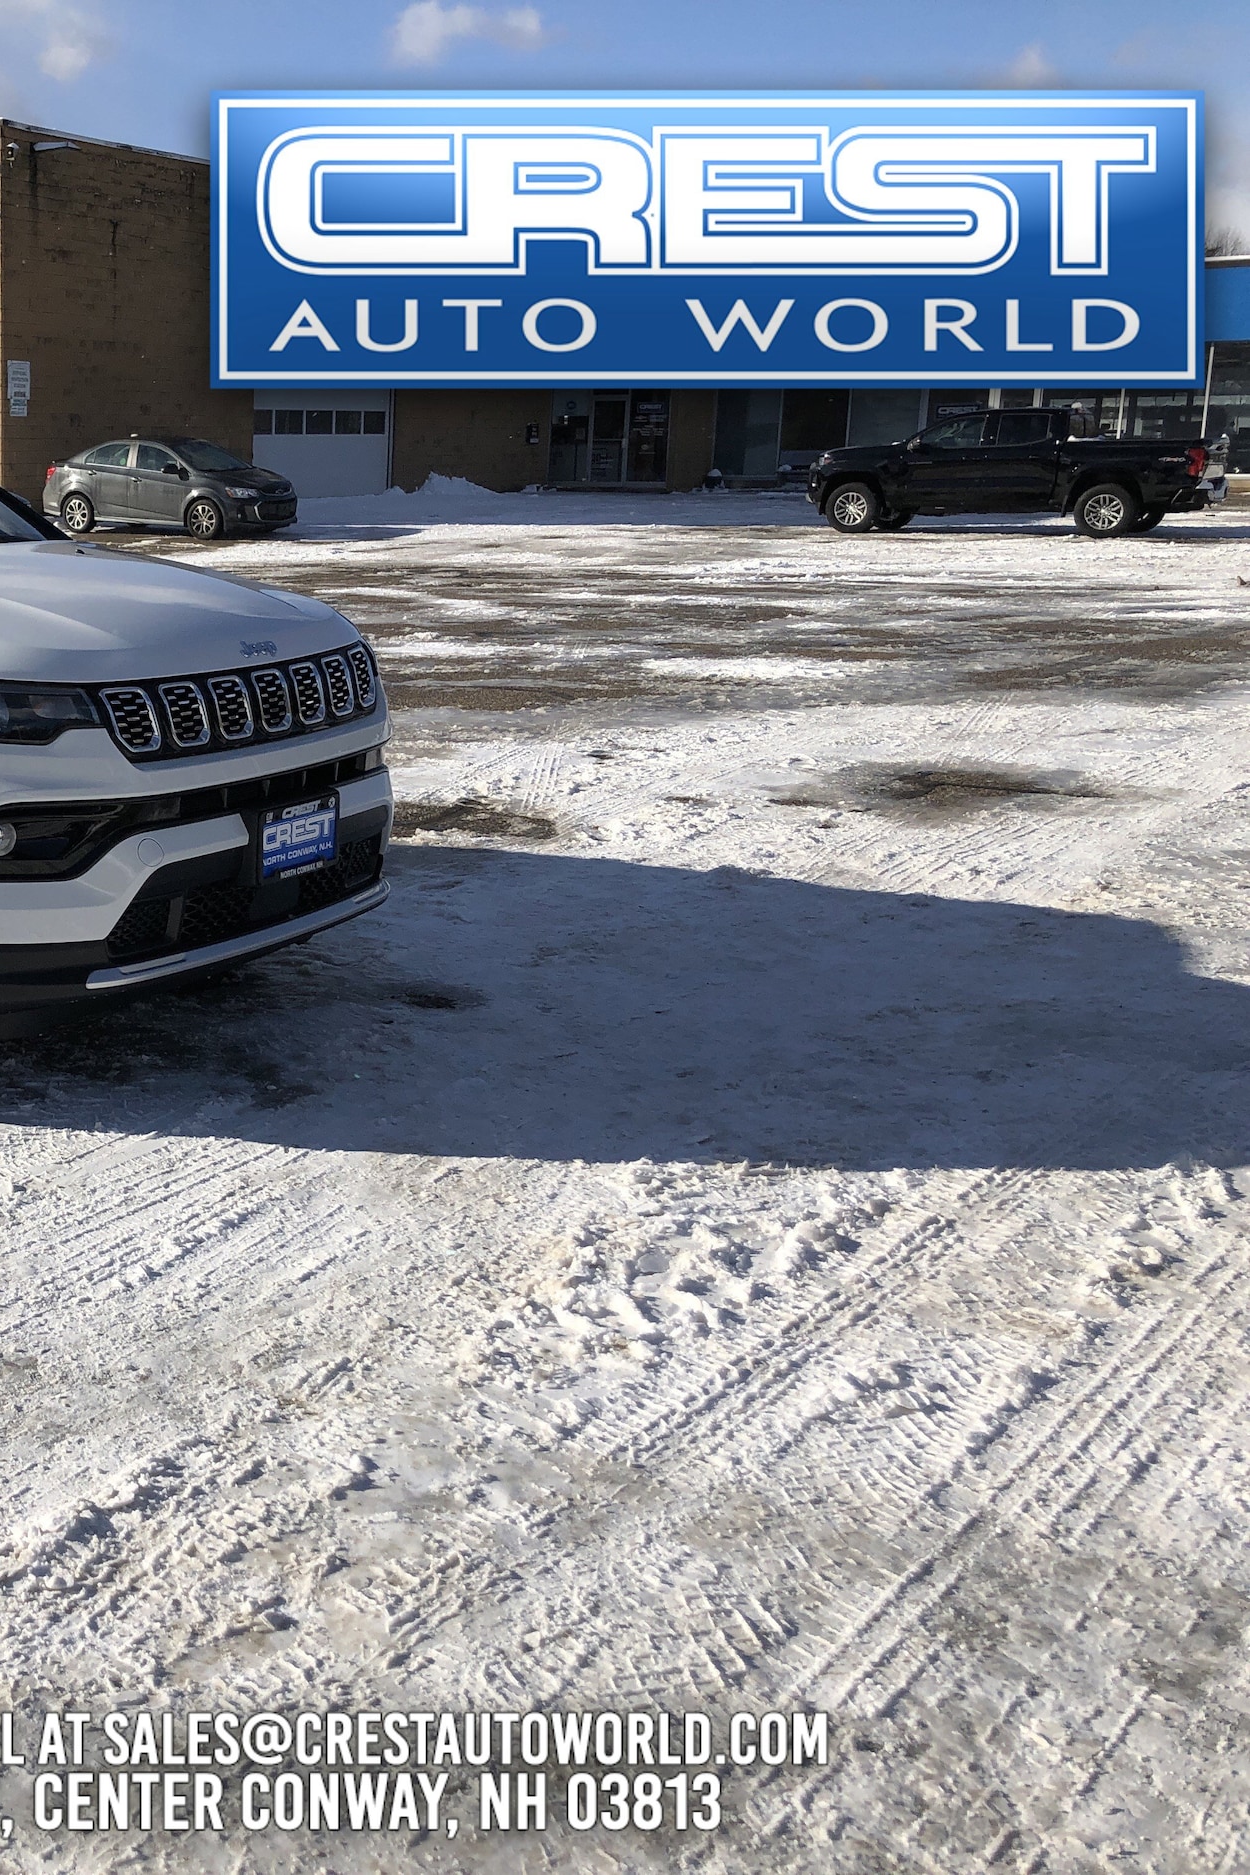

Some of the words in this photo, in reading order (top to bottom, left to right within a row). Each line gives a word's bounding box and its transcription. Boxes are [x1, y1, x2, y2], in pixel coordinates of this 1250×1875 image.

[239, 639, 277, 659] Jeep
[281, 800, 321, 819] CREST
[262, 811, 335, 853] CREST
[287, 845, 317, 859] CONWAY,
[279, 868, 297, 880] NORTH
